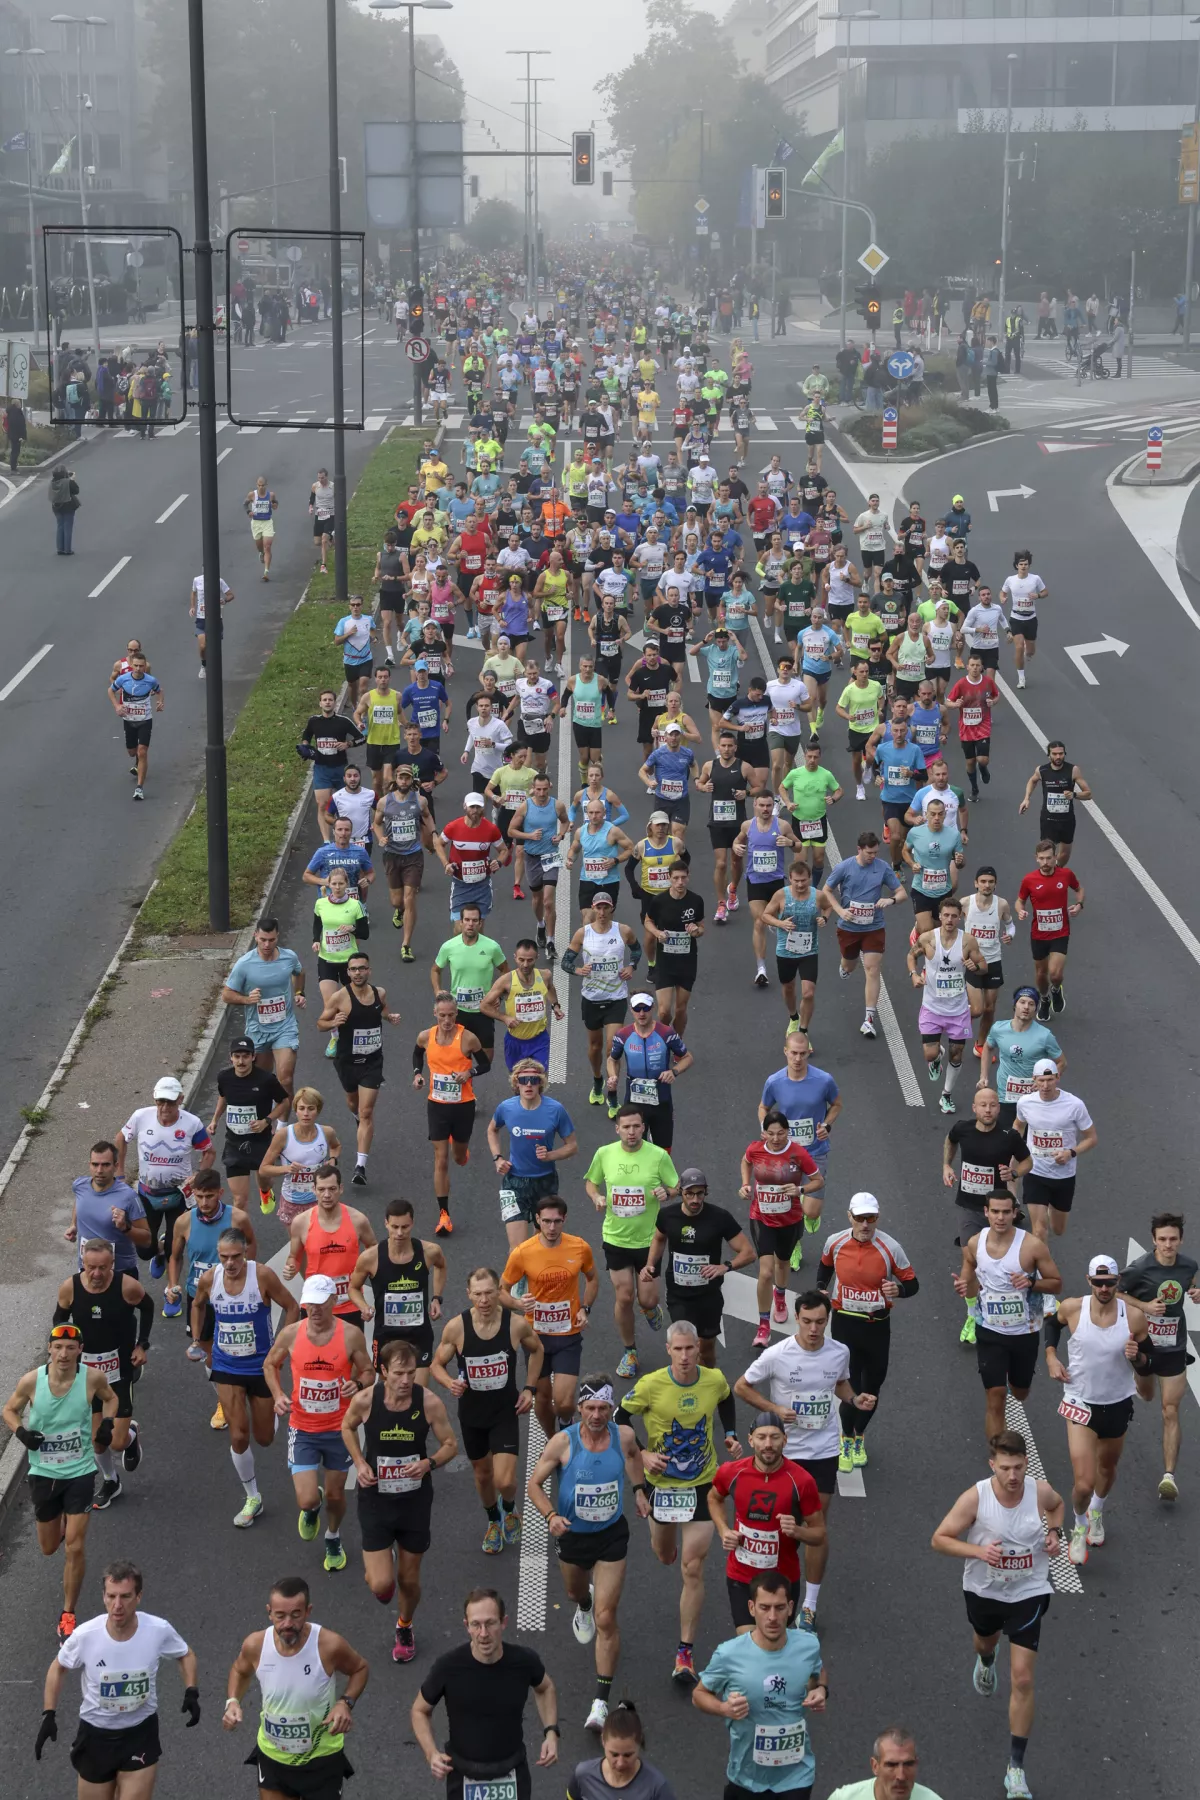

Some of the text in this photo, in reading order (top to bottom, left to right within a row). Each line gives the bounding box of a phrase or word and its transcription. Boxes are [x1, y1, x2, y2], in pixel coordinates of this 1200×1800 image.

[757, 857, 776, 865] A1938
[974, 930, 996, 938] A7541
[596, 962, 618, 972] A2003
[941, 980, 963, 988] A1166
[470, 994, 483, 1002] 182
[263, 1004, 284, 1014] A8318
[520, 1002, 543, 1012] B6498
[446, 1083, 460, 1092] 373
[635, 1085, 657, 1096] B 594
[231, 1114, 256, 1124] A1634
[1036, 1138, 1062, 1148] A3769
[143, 1151, 184, 1164] Slovenia
[966, 1173, 992, 1184] B6921
[618, 1195, 644, 1206] A7825
[763, 1193, 788, 1203] A7778
[848, 1289, 878, 1301] D6407
[214, 1302, 258, 1315] HELLAS
[392, 1302, 422, 1314] A 719
[994, 1302, 1022, 1314] A1991
[540, 1309, 570, 1322] A6372
[1148, 1322, 1176, 1335] A7038
[224, 1331, 253, 1344] A1475
[474, 1364, 506, 1378] A3379
[306, 1387, 338, 1400] A7641
[798, 1401, 830, 1415] A2145
[47, 1440, 81, 1452] A2474
[584, 1495, 618, 1506] A2666
[662, 1496, 695, 1507] B1570
[743, 1538, 776, 1554] A7041
[996, 1556, 1031, 1570] A4801
[108, 1680, 148, 1698] A 451
[270, 1722, 308, 1738] A2395
[764, 1735, 802, 1750] B1733
[474, 1785, 515, 1800] A2350
